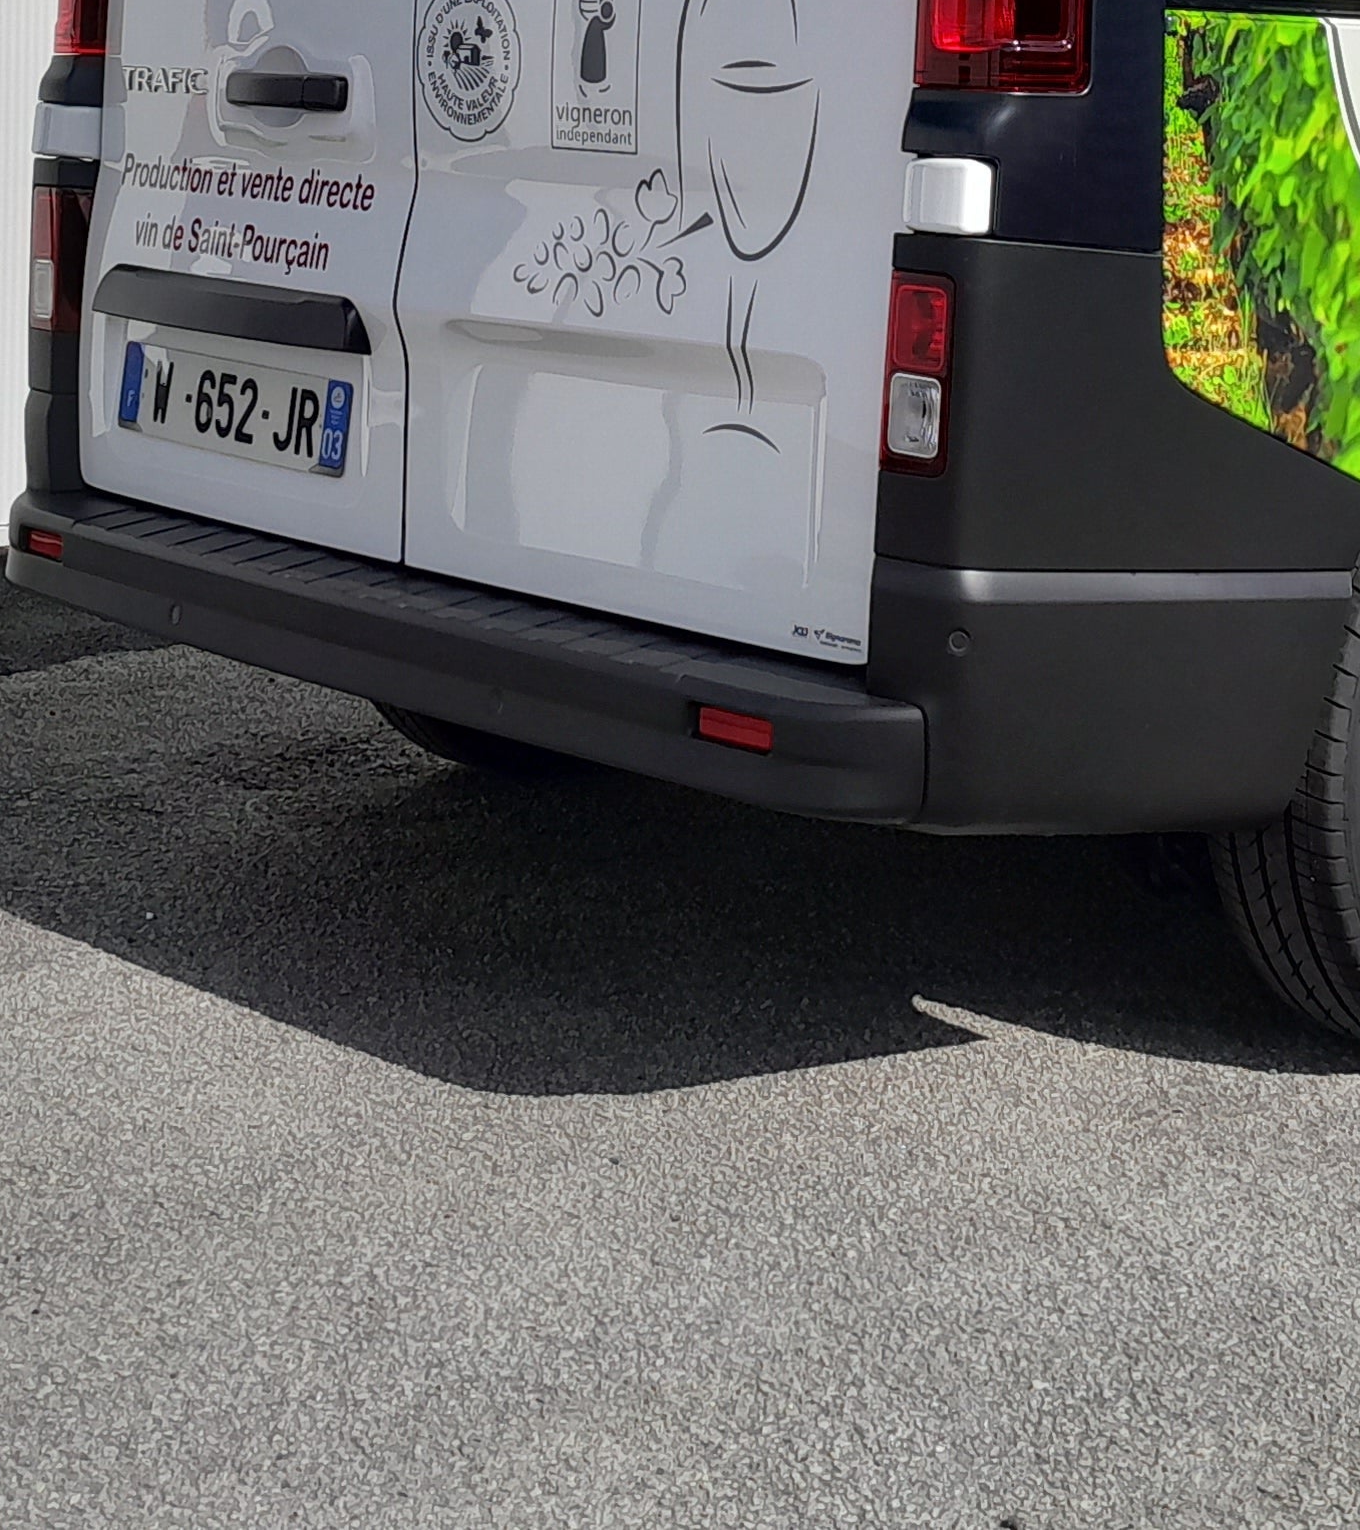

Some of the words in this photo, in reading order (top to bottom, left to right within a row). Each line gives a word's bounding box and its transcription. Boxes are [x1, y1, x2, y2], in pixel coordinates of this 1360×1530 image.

[426, 26, 439, 58] ISSU
[122, 65, 209, 95] TRAFIC
[427, 70, 510, 126] ENVIRONNEMENTALE
[437, 73, 465, 110] HAUTE
[466, 75, 499, 112] VALEUR
[555, 101, 633, 129] vigneron
[121, 153, 213, 195] Production
[217, 162, 237, 198] et
[241, 166, 294, 203] vente
[298, 168, 375, 211] directe
[135, 213, 158, 249] vin
[162, 215, 184, 251] de
[188, 218, 329, 276] Saint-Pourçain
[321, 427, 344, 461] 03
